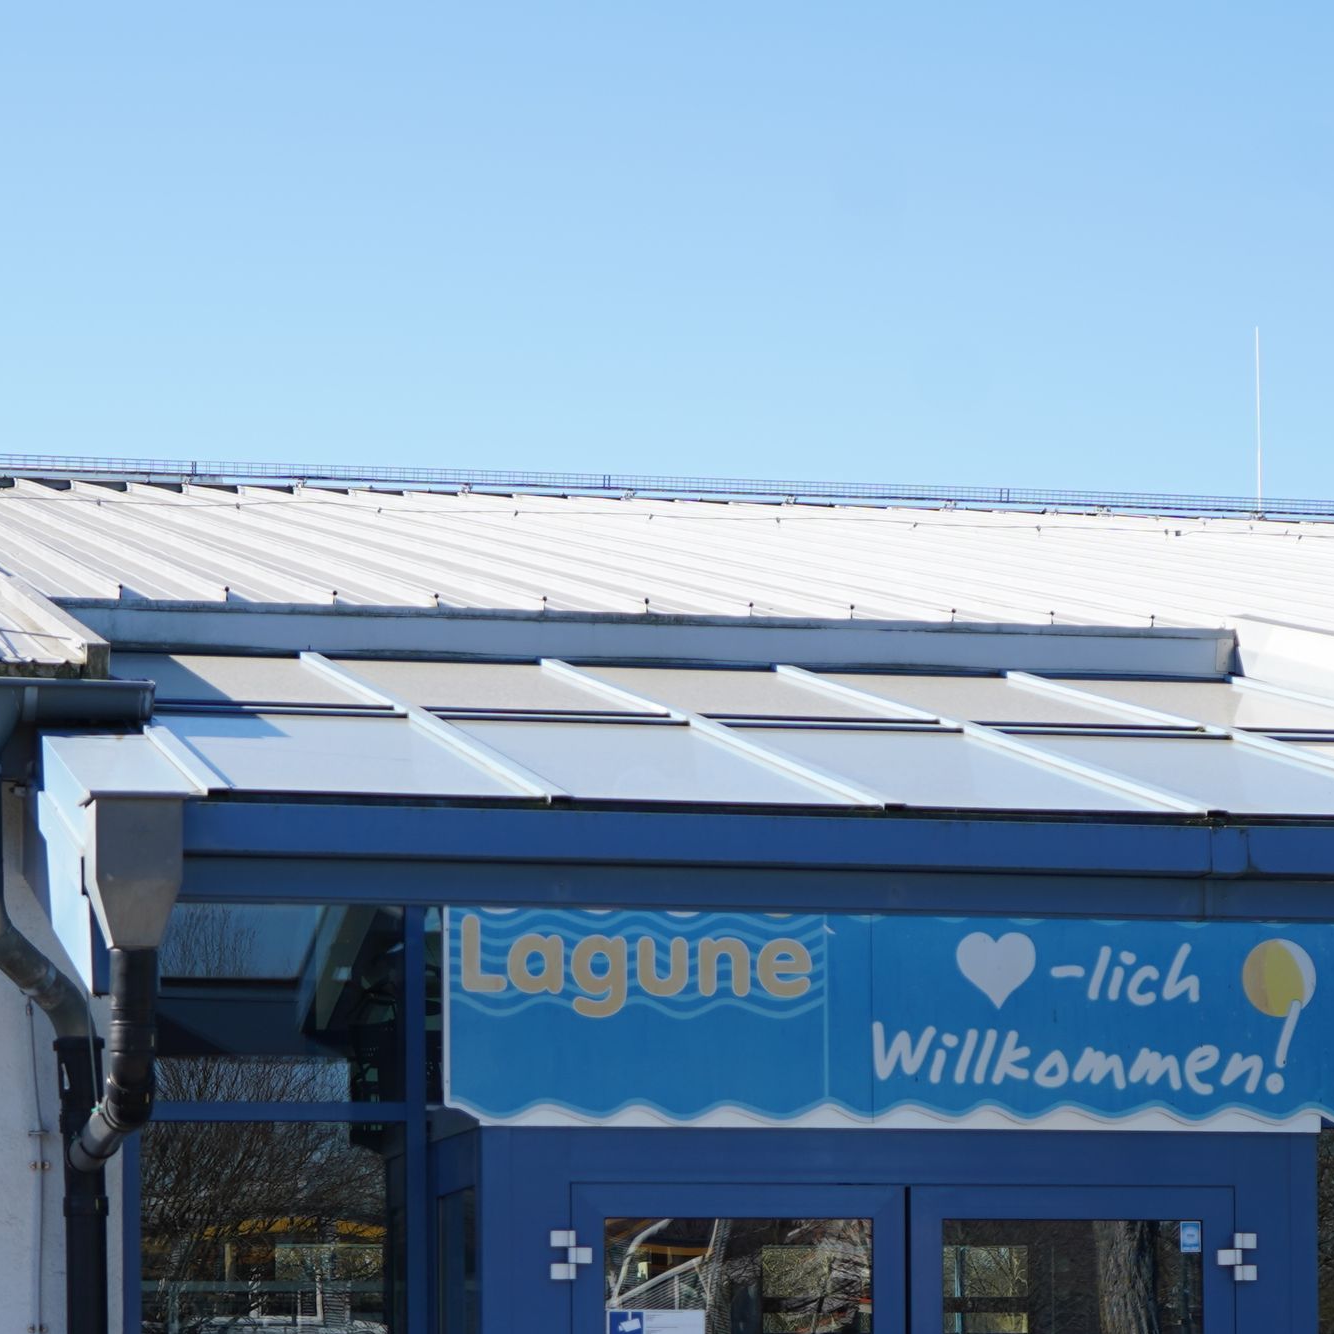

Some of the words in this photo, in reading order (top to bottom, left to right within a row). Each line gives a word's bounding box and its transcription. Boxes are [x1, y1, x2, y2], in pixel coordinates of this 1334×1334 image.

[460, 915, 813, 1019] Lagune
[1050, 942, 1202, 1008] -lich
[871, 999, 1303, 1097] Willkommen!
